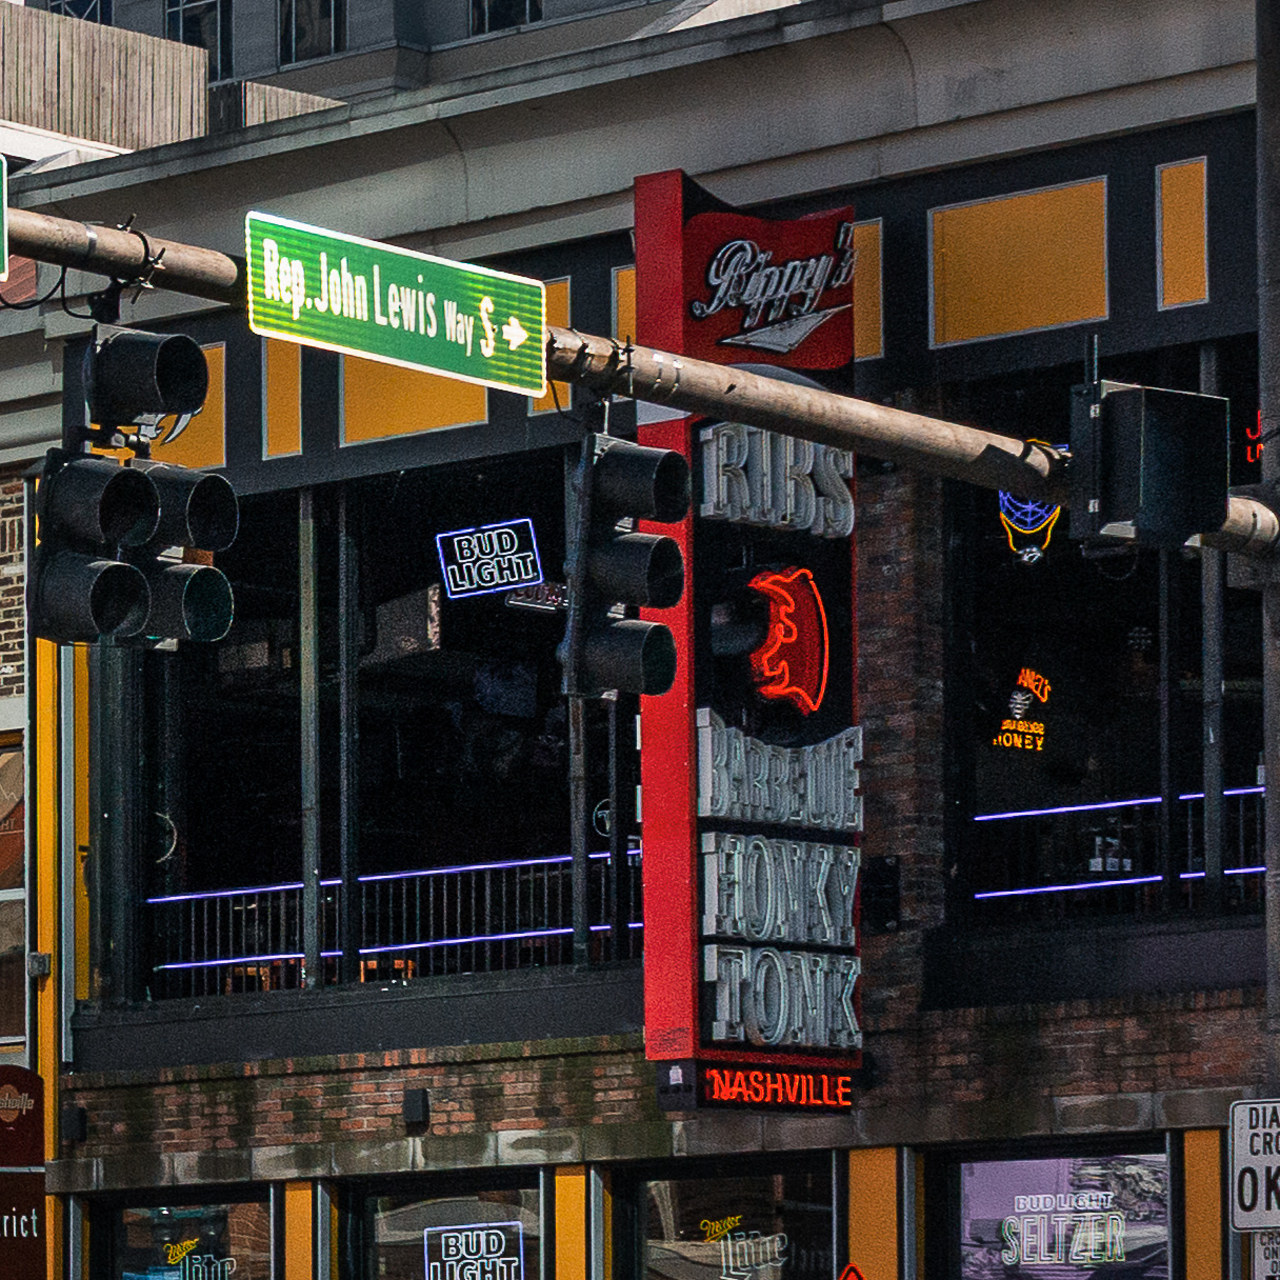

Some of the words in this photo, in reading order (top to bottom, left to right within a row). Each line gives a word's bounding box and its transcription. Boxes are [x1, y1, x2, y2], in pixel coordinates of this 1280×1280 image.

[262, 238, 311, 319] Rep.
[313, 257, 368, 321] John
[373, 263, 438, 339] Lewis
[444, 305, 475, 357] Way
[479, 295, 495, 359] S
[692, 222, 857, 329] Rippy's
[700, 421, 856, 539] RIBS
[447, 552, 535, 592] LIGHT
[454, 528, 519, 563] BUD
[702, 832, 861, 946] HONKY
[703, 943, 862, 1048] TONK
[706, 1068, 852, 1106] NASHVILLE
[1014, 1194, 1056, 1212] BUD
[1056, 1191, 1114, 1211] LIGHT
[440, 1228, 503, 1260] BUD
[1001, 1211, 1126, 1266] SELTZER
